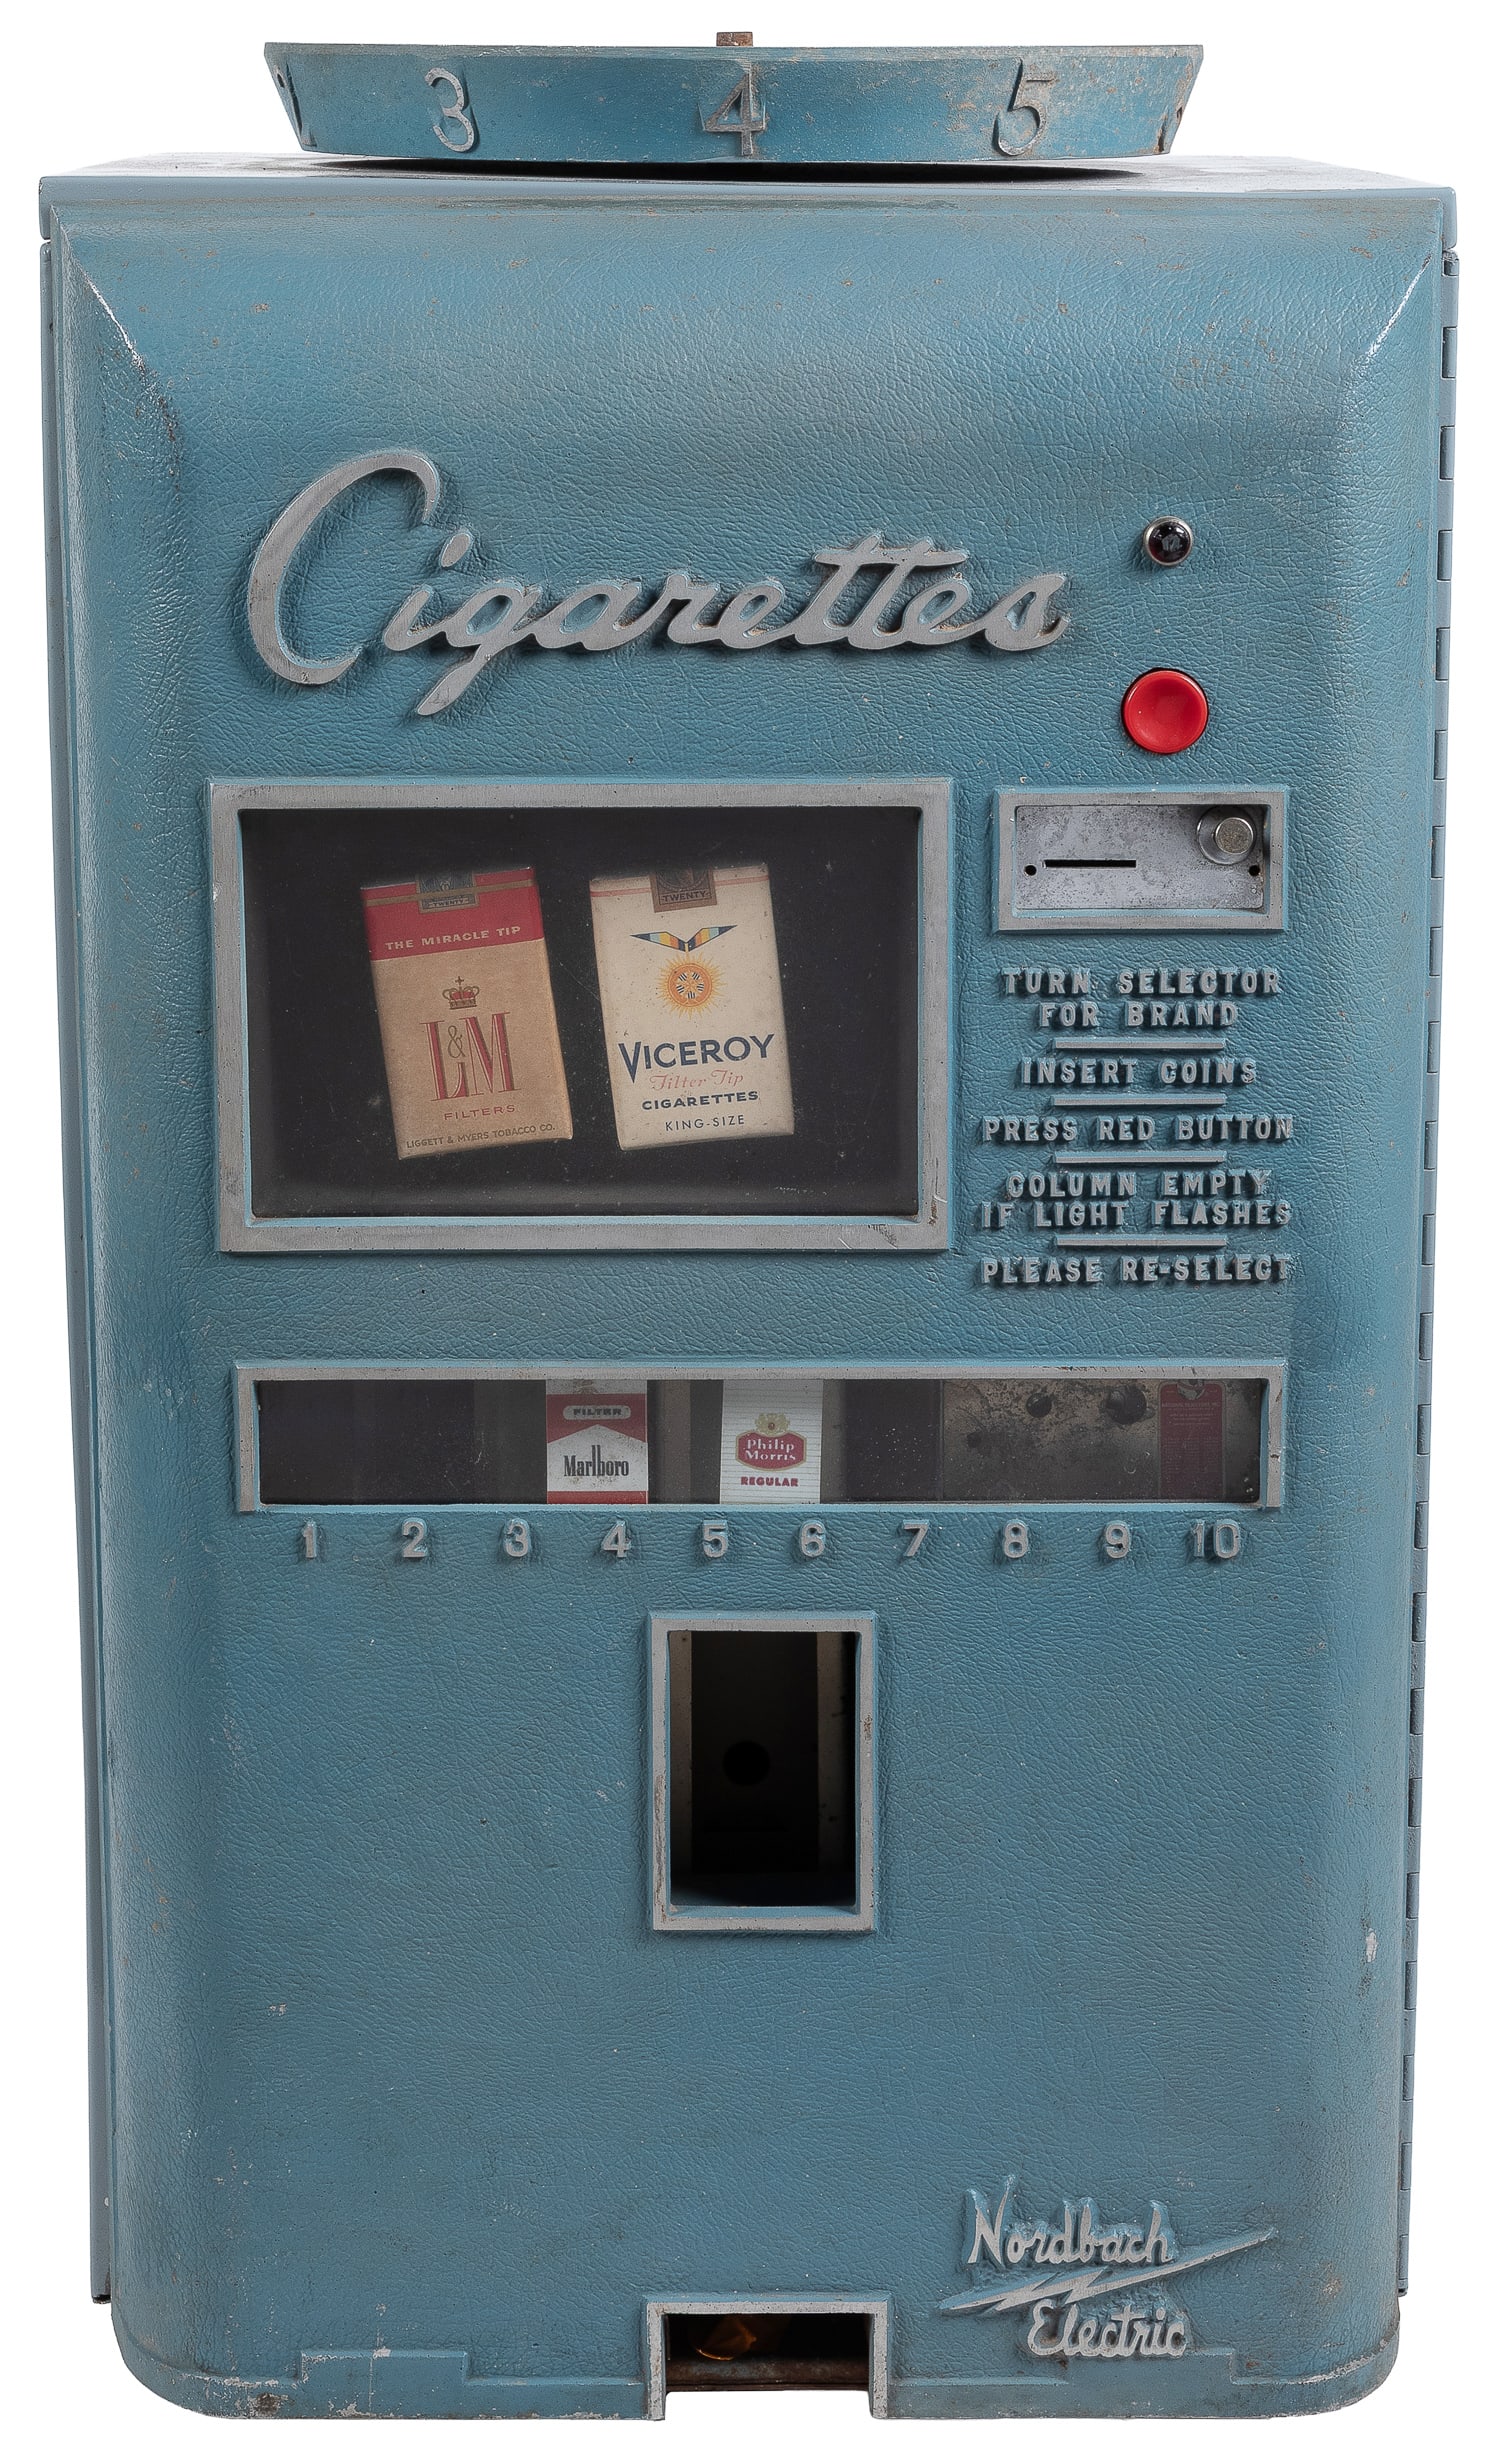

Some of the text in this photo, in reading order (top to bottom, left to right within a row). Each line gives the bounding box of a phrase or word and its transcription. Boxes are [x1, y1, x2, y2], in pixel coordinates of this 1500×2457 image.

[424, 65, 1060, 157] 3 4 5
[247, 449, 1072, 717] Cigarettes
[662, 890, 706, 902] TWENTY
[385, 925, 522, 951] THE MIRACLE TIP
[1001, 967, 1280, 994] TURN SELECTOR
[1039, 1001, 1239, 1027] FOR BRAND
[419, 1012, 522, 1101] L&M
[618, 1033, 775, 1084] VICEROY
[650, 1069, 744, 1091] Filter Tip
[1020, 1057, 1257, 1084] INSERT COINS
[443, 1104, 516, 1121] FILTERS
[642, 1090, 759, 1111] CIGARETTES
[406, 1124, 556, 1149] LIGGETT & MYERS TOBACCO CO.
[665, 1114, 745, 1132] KING-SIZE
[982, 1114, 1294, 1141] PRESS RED BUTTON
[1006, 1169, 1271, 1198] COLUMN EMPTY
[980, 1200, 1293, 1228] IF LIGHT FLASHES
[981, 1254, 1291, 1284] PLEASE RE-SELECT
[573, 1407, 622, 1416] FILTER
[745, 1450, 796, 1461] Morris
[746, 1438, 795, 1454] Philip
[563, 1444, 629, 1478] Marlboro
[740, 1476, 799, 1488] REGULAR
[302, 1518, 1241, 1560] 1 2 3 4 5 6 7 8 9 10
[967, 2175, 1174, 2265] Nordbach
[1027, 2299, 1187, 2358] Electric
